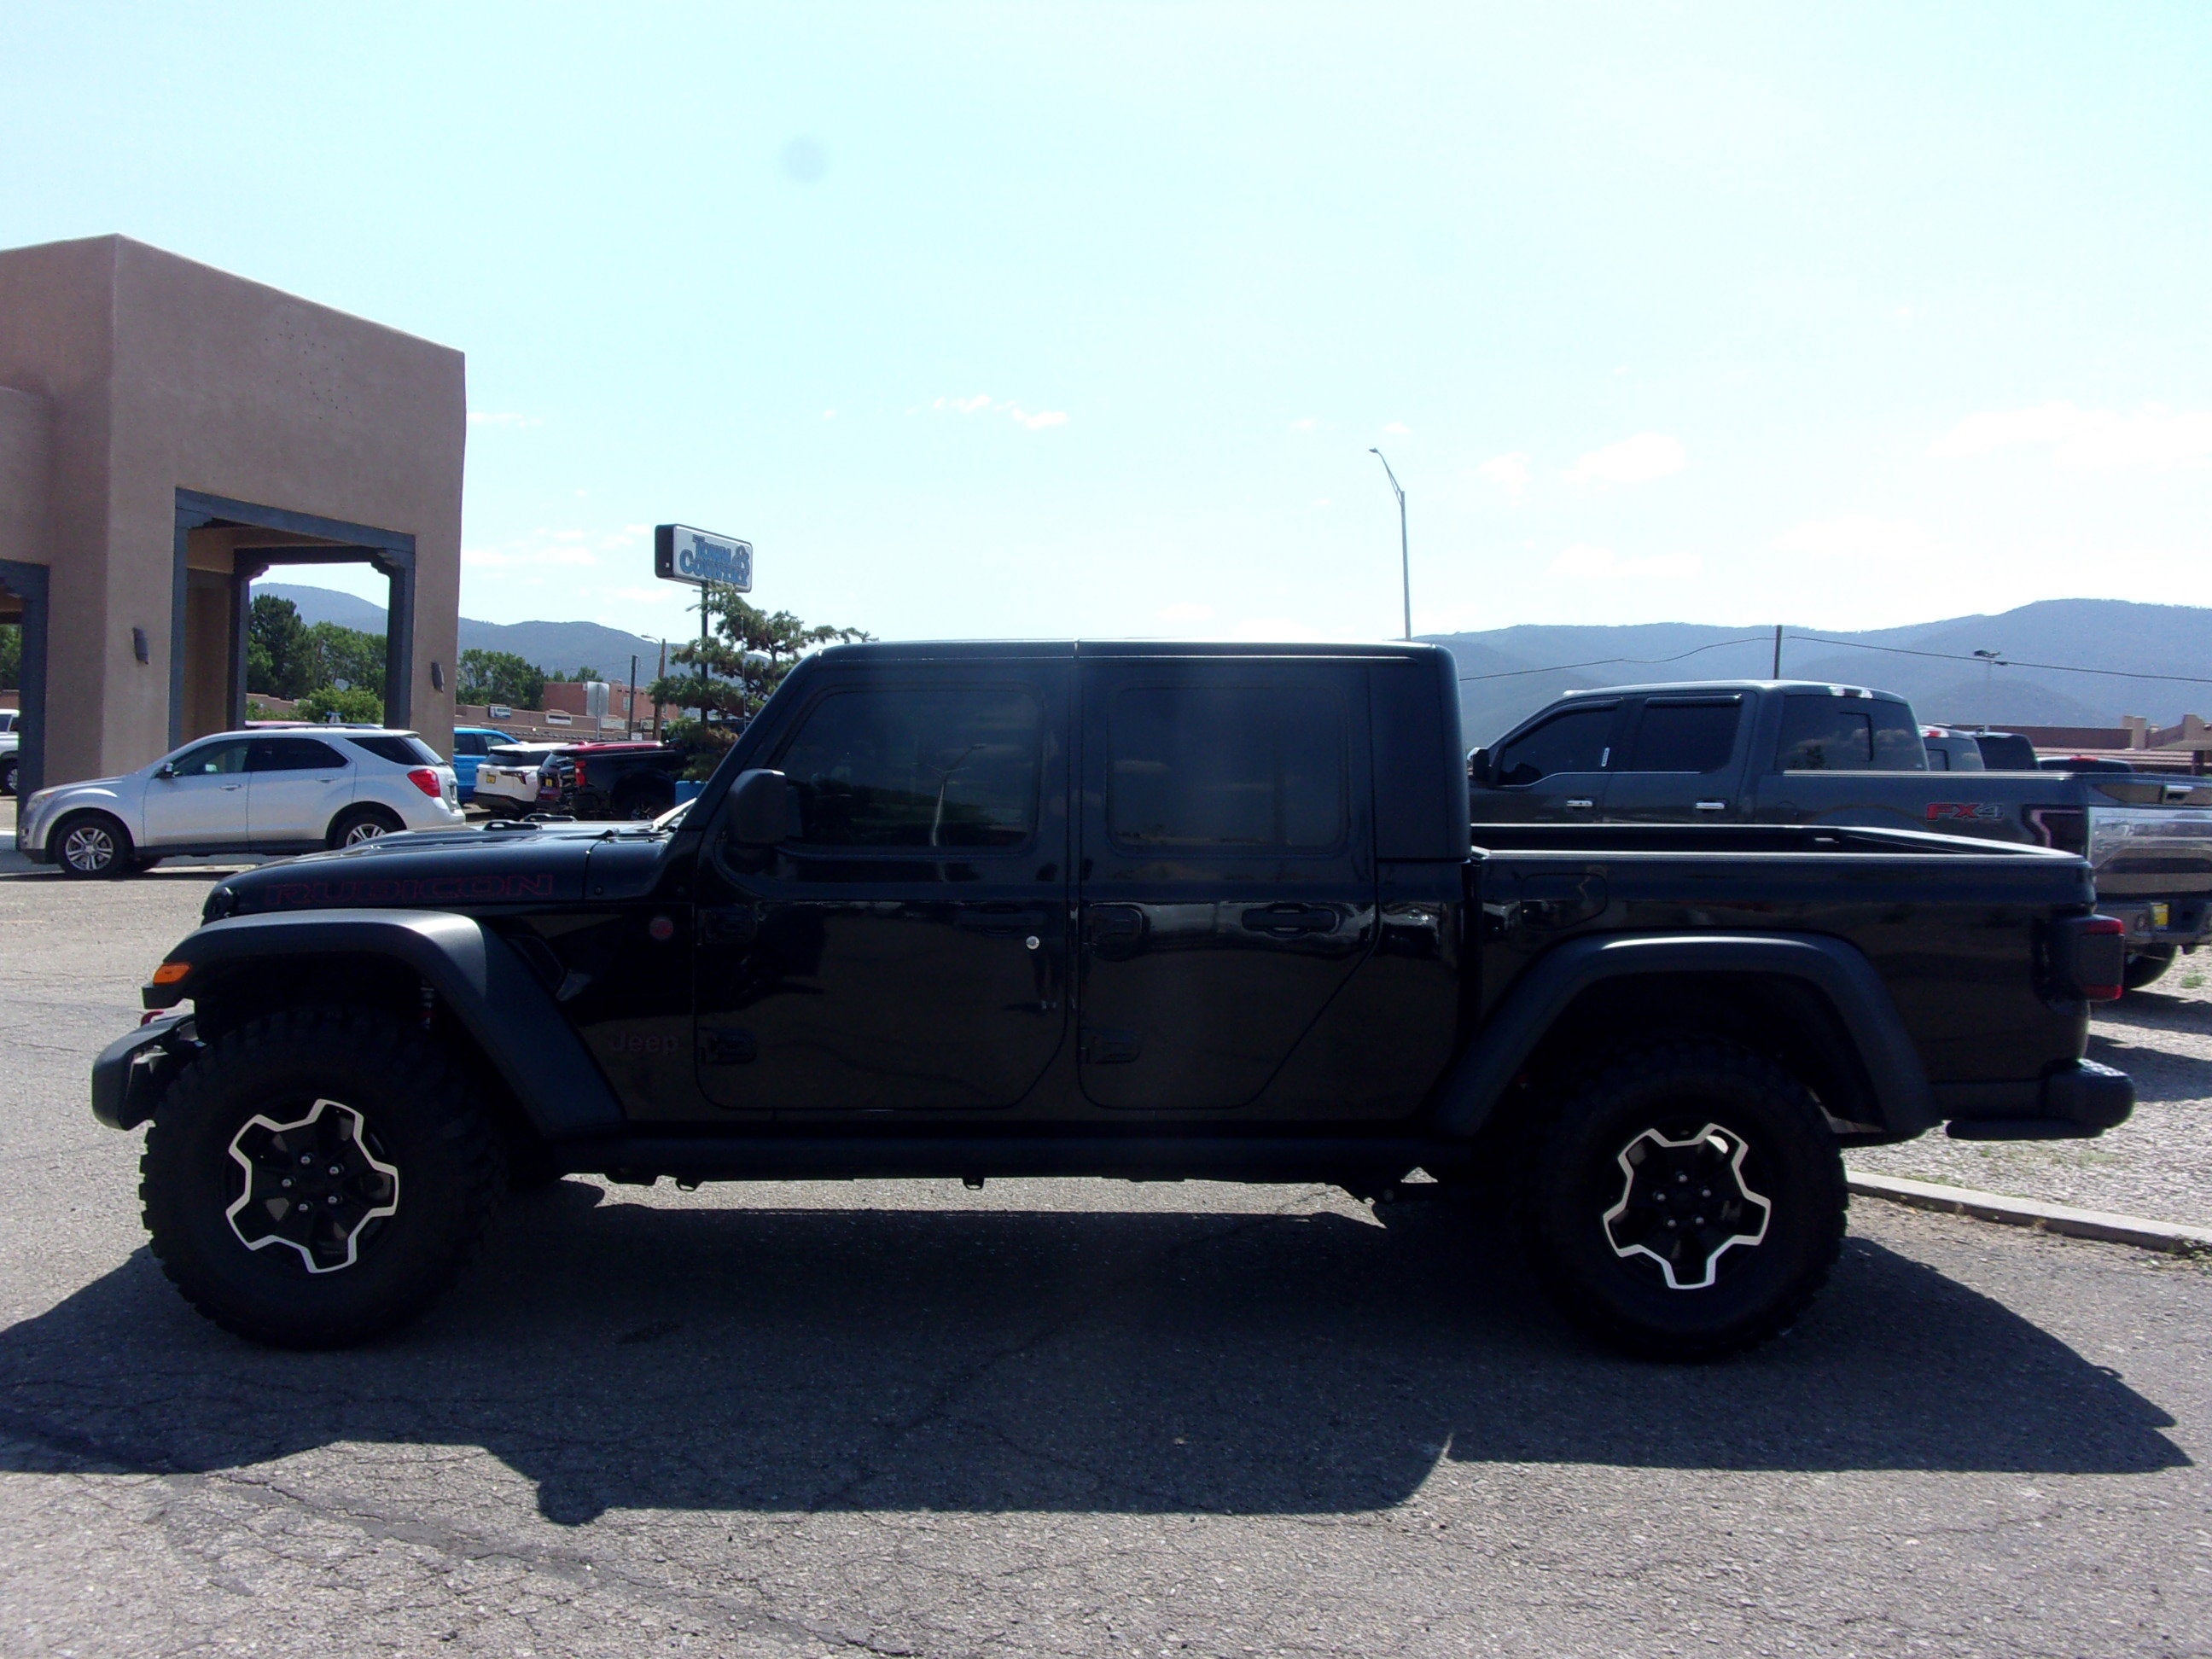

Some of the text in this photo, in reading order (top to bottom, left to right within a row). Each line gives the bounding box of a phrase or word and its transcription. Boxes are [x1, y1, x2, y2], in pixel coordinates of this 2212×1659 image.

[1926, 803, 2003, 820] FX4
[265, 875, 554, 905] RUBICON
[608, 1031, 674, 1054] Jeep
